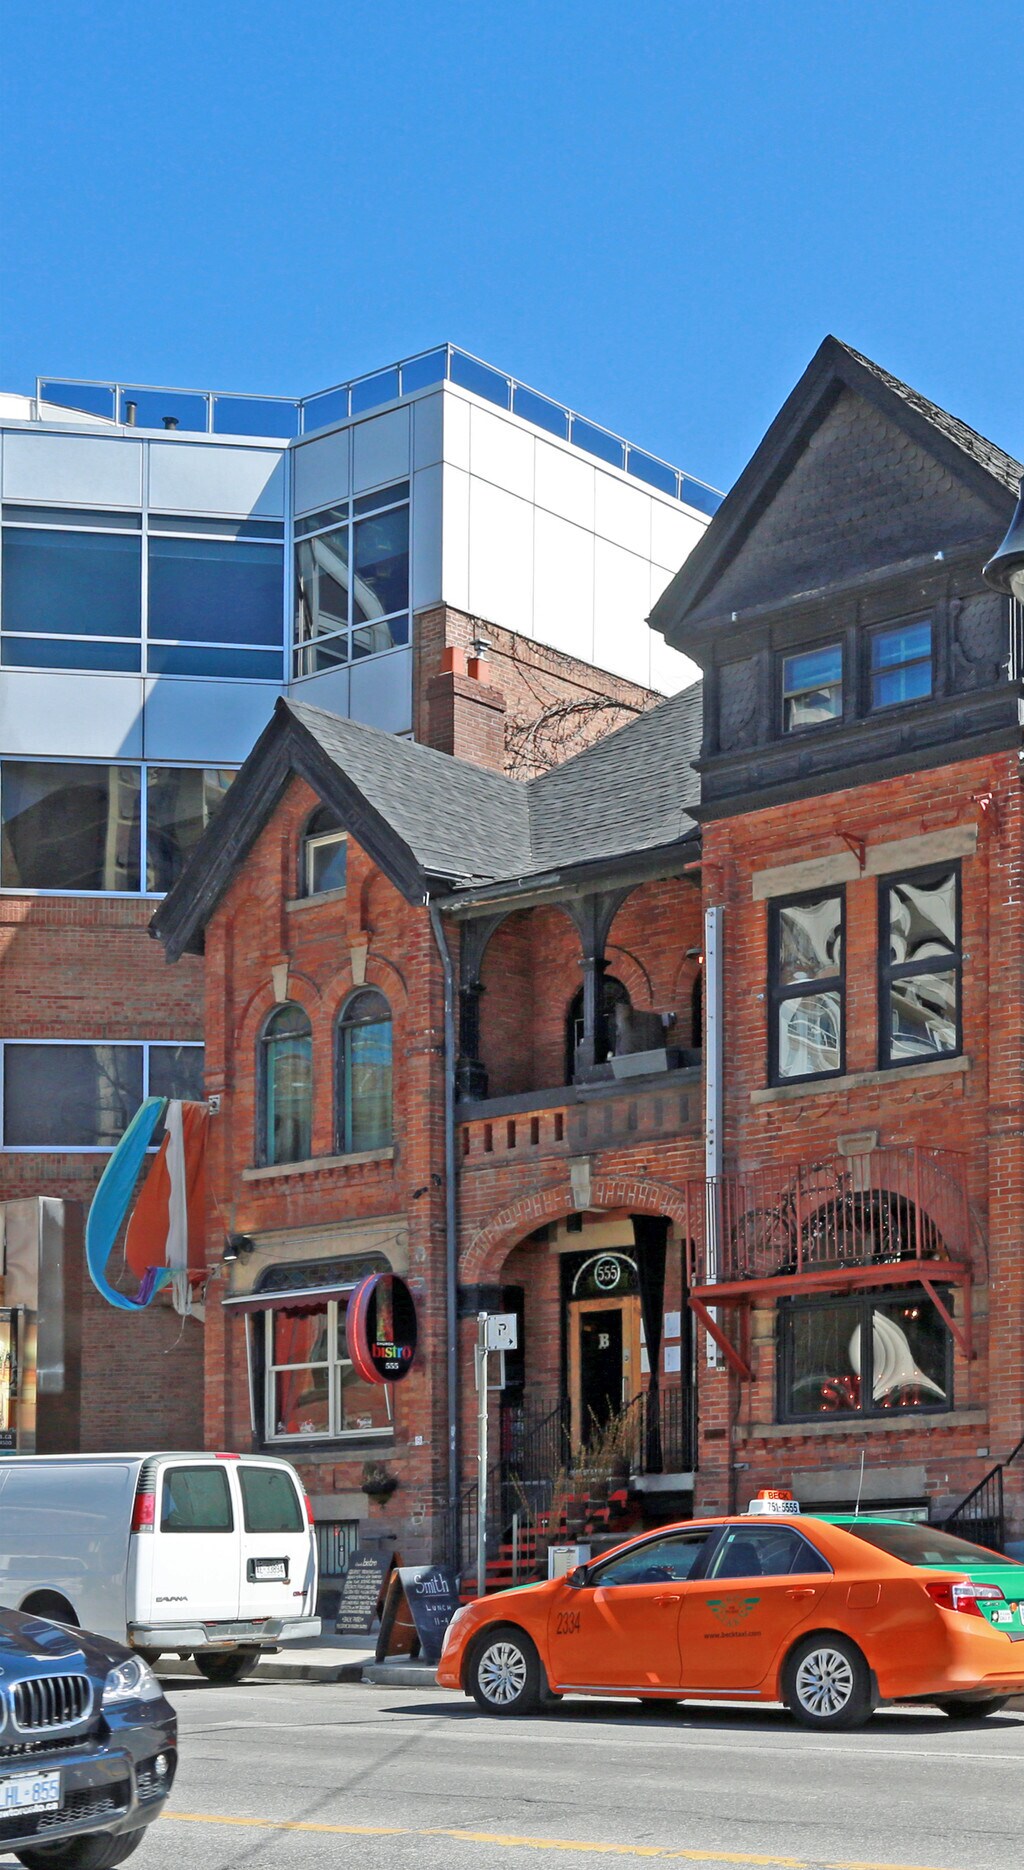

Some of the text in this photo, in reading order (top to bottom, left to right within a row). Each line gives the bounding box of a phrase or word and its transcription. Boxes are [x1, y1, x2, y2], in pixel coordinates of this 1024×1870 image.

[598, 1266, 617, 1281] 555
[372, 1343, 412, 1360] bistro
[767, 1491, 789, 1500] BECK
[767, 1502, 798, 1513] 751-5555
[414, 1574, 450, 1594] Smith
[556, 1611, 581, 1635] 2334
